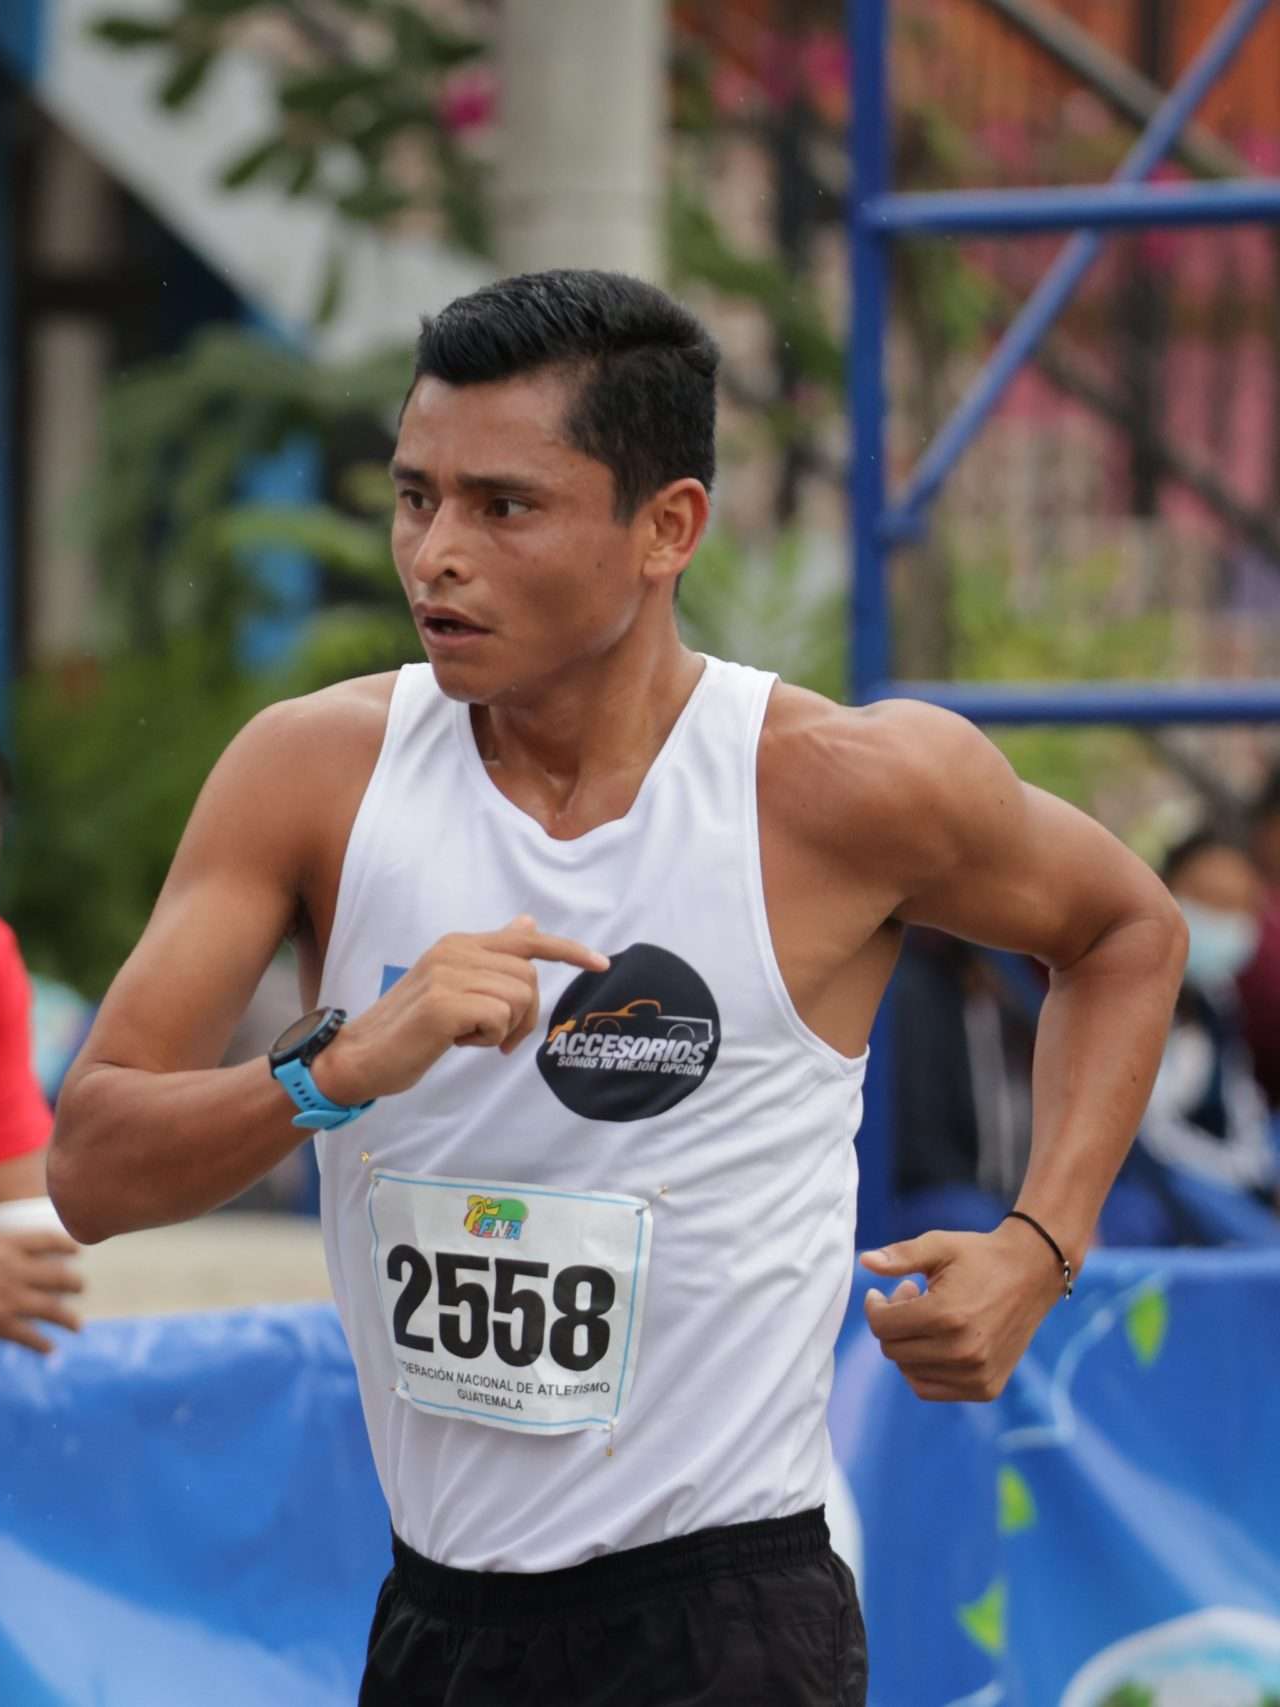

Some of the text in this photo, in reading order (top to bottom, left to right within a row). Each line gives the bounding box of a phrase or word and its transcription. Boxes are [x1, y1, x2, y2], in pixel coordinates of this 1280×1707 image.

[546, 1032, 709, 1065] ACCESORIOS
[557, 1056, 597, 1069] SOMOS
[600, 1058, 616, 1070] TU
[616, 1058, 658, 1073] MEJOR
[386, 1244, 616, 1371] 2558
[456, 1370, 514, 1392] NACIONAL
[516, 1382, 533, 1395] DE
[537, 1382, 610, 1396] ATLETISMO
[457, 1388, 524, 1410] GUATEMALA
